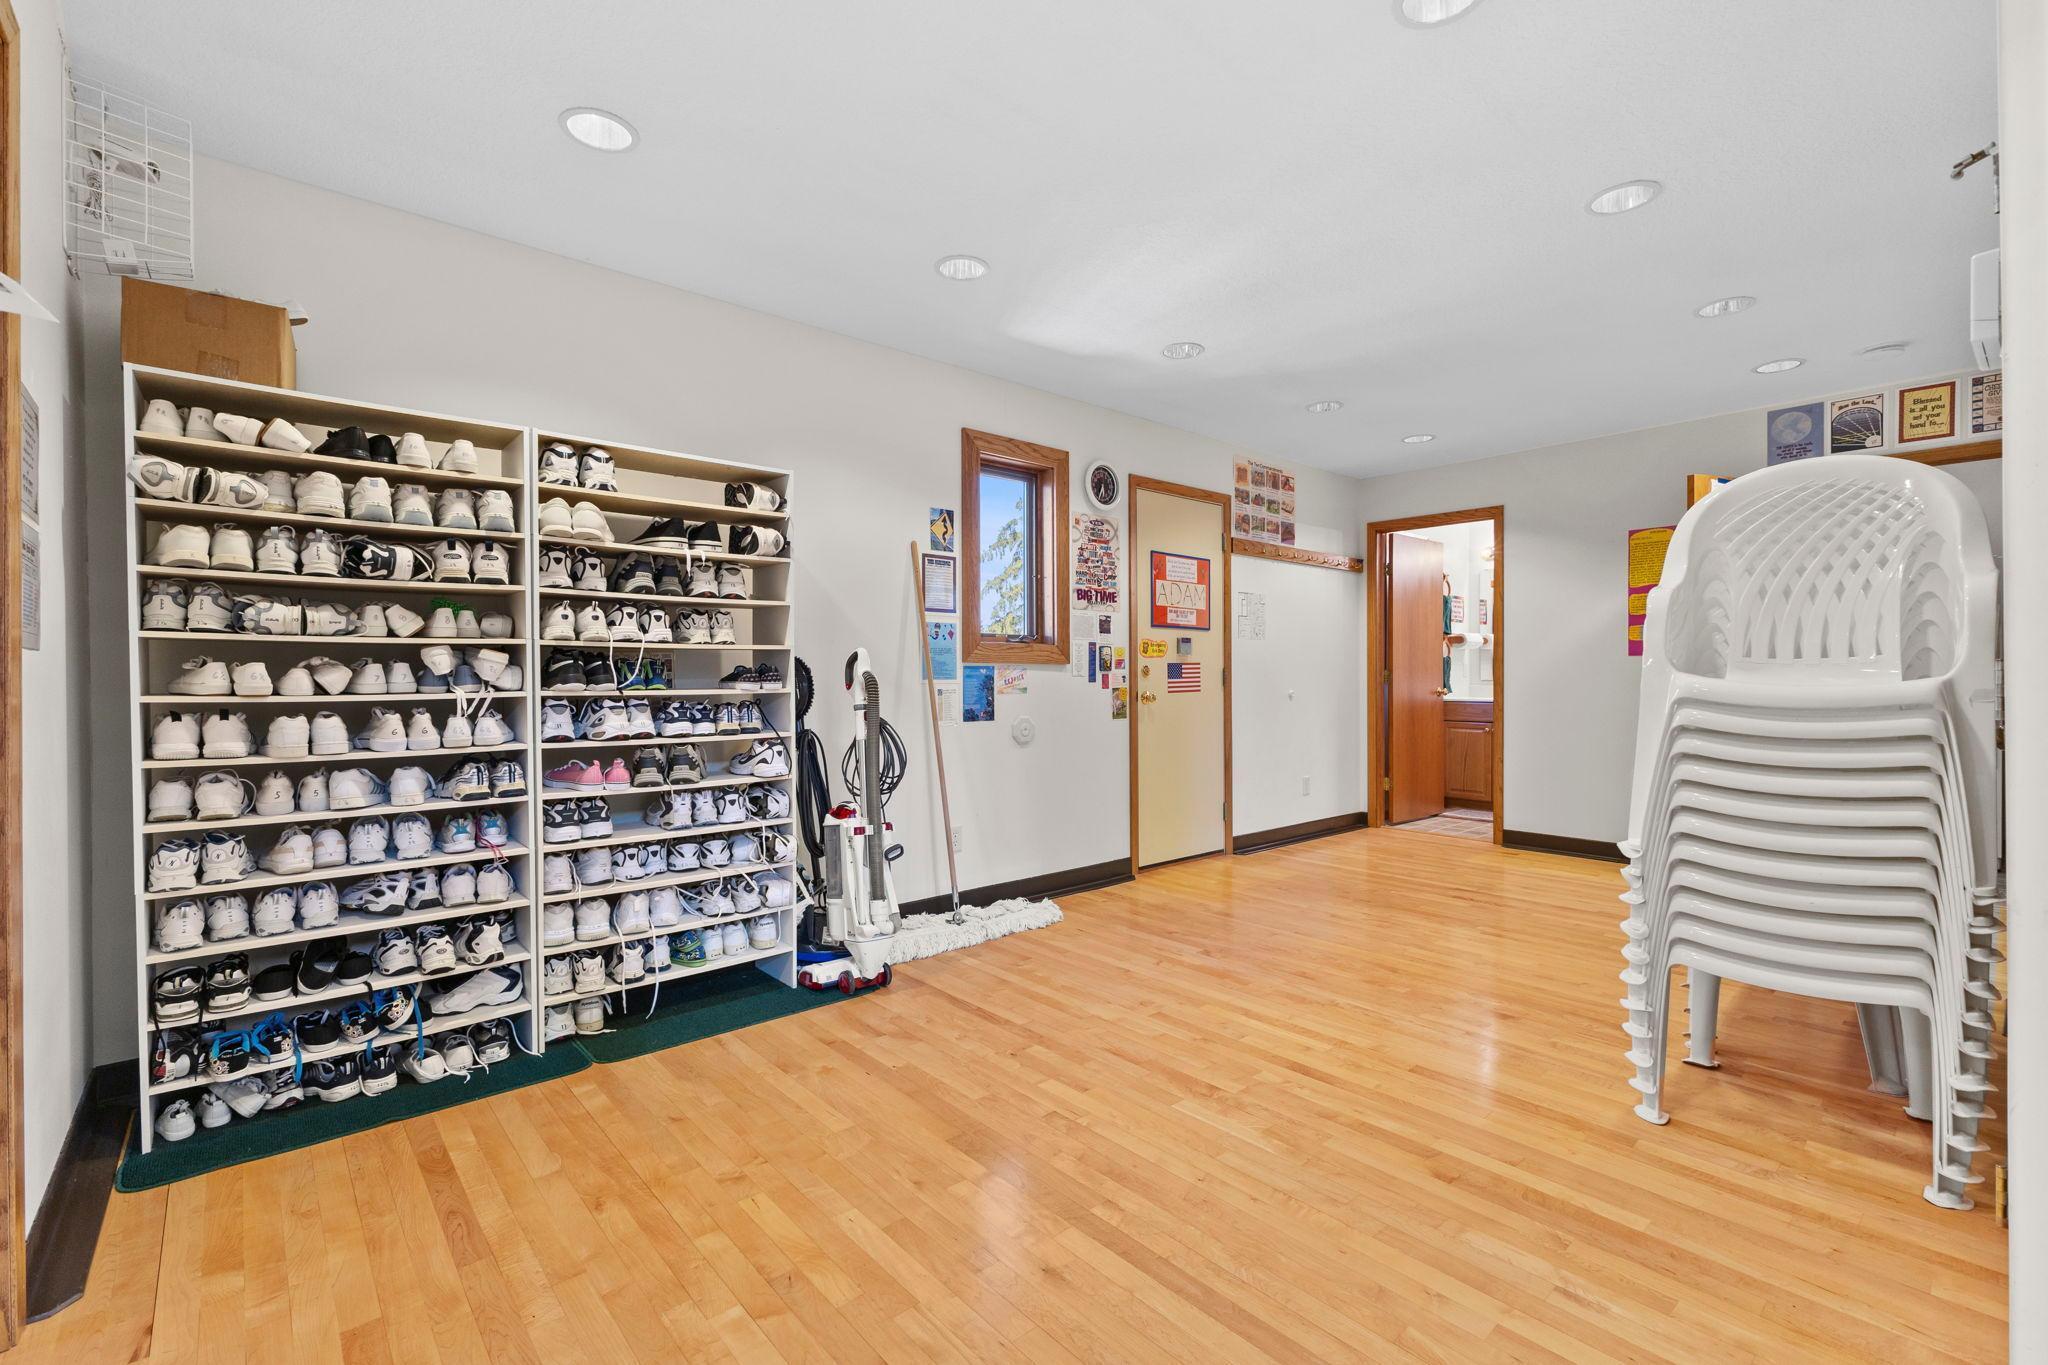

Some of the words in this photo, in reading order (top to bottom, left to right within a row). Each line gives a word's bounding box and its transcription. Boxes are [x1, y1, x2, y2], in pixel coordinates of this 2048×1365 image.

[1913, 395, 1942, 404] Blessed
[1931, 404, 1945, 412] you
[1926, 412, 1941, 420] your
[1910, 421, 1926, 429] hand
[1094, 591, 1117, 604] TIME
[1157, 583, 1205, 608] ADAM
[421, 726, 428, 734] 6
[274, 790, 281, 799] 5
[313, 789, 319, 797] 5
